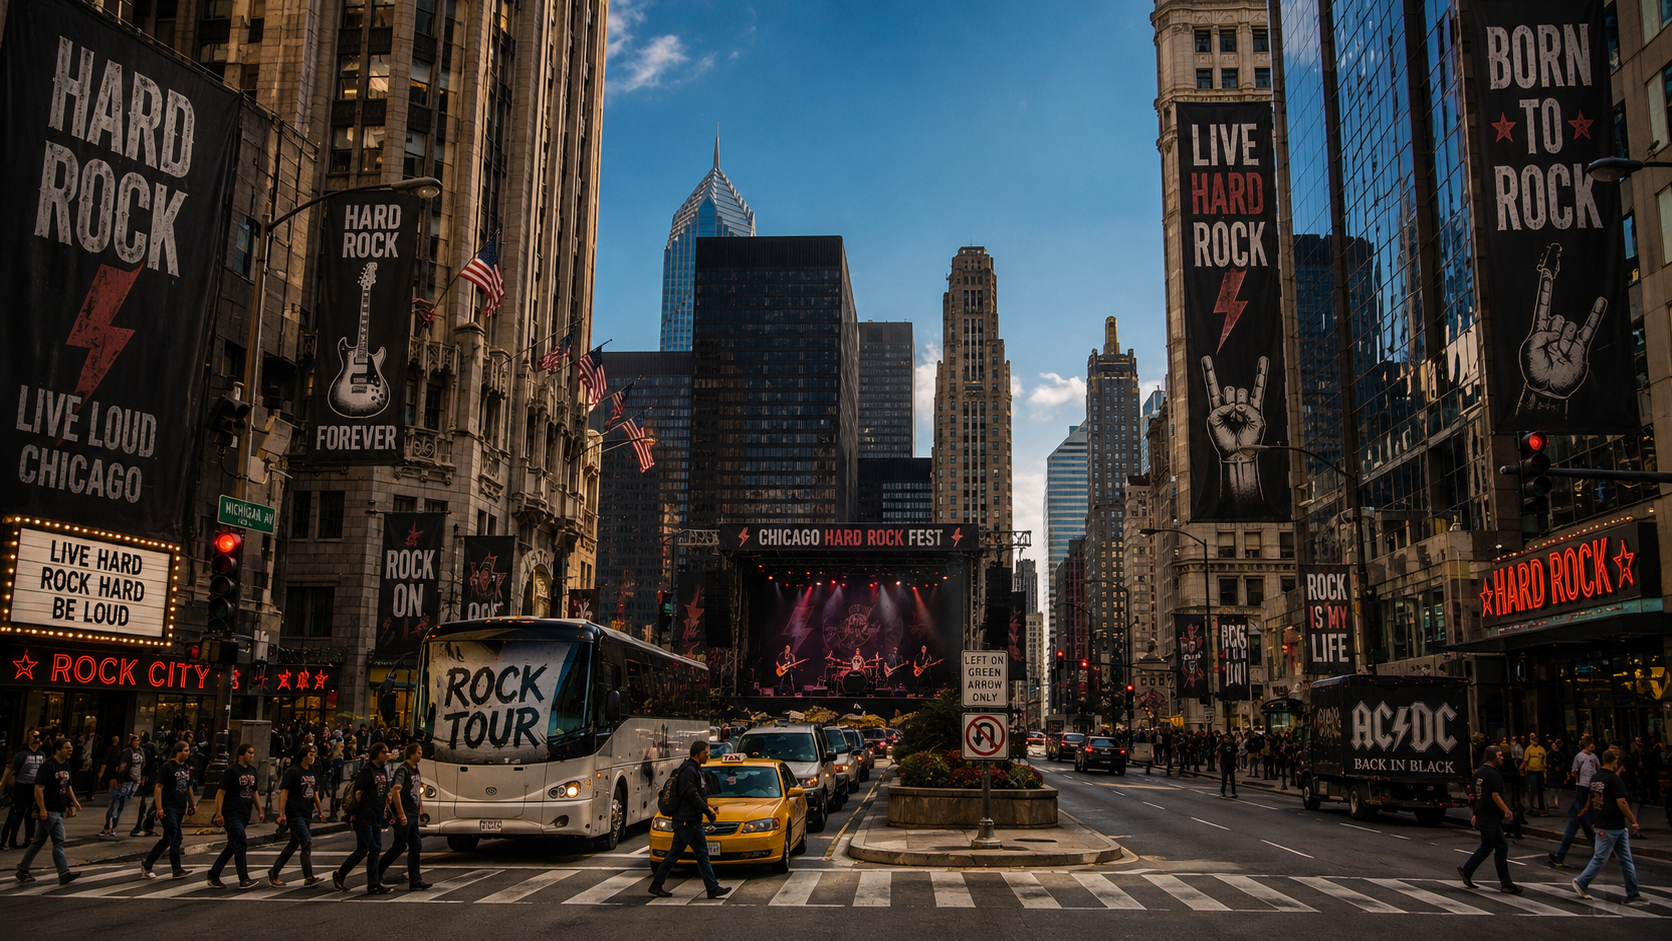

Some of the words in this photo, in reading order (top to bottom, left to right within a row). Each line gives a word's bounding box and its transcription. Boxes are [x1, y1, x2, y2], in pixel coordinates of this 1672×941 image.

[1485, 23, 1593, 90] BORN
[47, 35, 195, 178] HARD
[1191, 123, 1260, 167] LIVE
[1519, 98, 1563, 156] TO
[33, 140, 189, 278] ROCK
[1190, 172, 1265, 216] HARD
[1494, 161, 1604, 232] ROCK
[344, 204, 401, 230] HARD
[342, 231, 399, 259] ROCK
[1193, 220, 1269, 268] ROCK
[15, 384, 82, 443] LIVE
[87, 400, 157, 458] LOUD
[315, 425, 397, 451] FOREVER
[18, 444, 142, 504] CHICAGO
[759, 528, 820, 546] CHICAGO
[824, 529, 863, 546] HARD
[867, 529, 904, 546] ROCK
[908, 529, 943, 546] FEST
[50, 539, 91, 567] LIVE
[97, 548, 143, 575] HARD
[385, 549, 435, 580] ROCK
[40, 566, 91, 595] ROCK
[98, 575, 145, 602] HARD
[1306, 573, 1348, 601] ROCK
[1493, 558, 1545, 616] HARD
[1549, 537, 1613, 604] ROCK
[52, 596, 77, 621] BE
[83, 601, 129, 626] LOUD
[392, 583, 424, 618] ON
[1309, 605, 1324, 629] IS
[1327, 605, 1348, 629] MY
[965, 656, 987, 665] LEFT
[991, 656, 1004, 665] ON
[1311, 633, 1349, 663] LIFE
[50, 653, 139, 686] ROCK
[148, 661, 211, 689] CITY
[444, 663, 548, 709] ROCK
[968, 668, 1001, 677] GREEN
[968, 680, 1002, 689] ARROW
[972, 693, 998, 702] ONLY
[443, 706, 541, 750] TOUR
[1353, 758, 1387, 771] BACK
[1390, 759, 1405, 772] IN
[1409, 760, 1455, 774] BLACK
